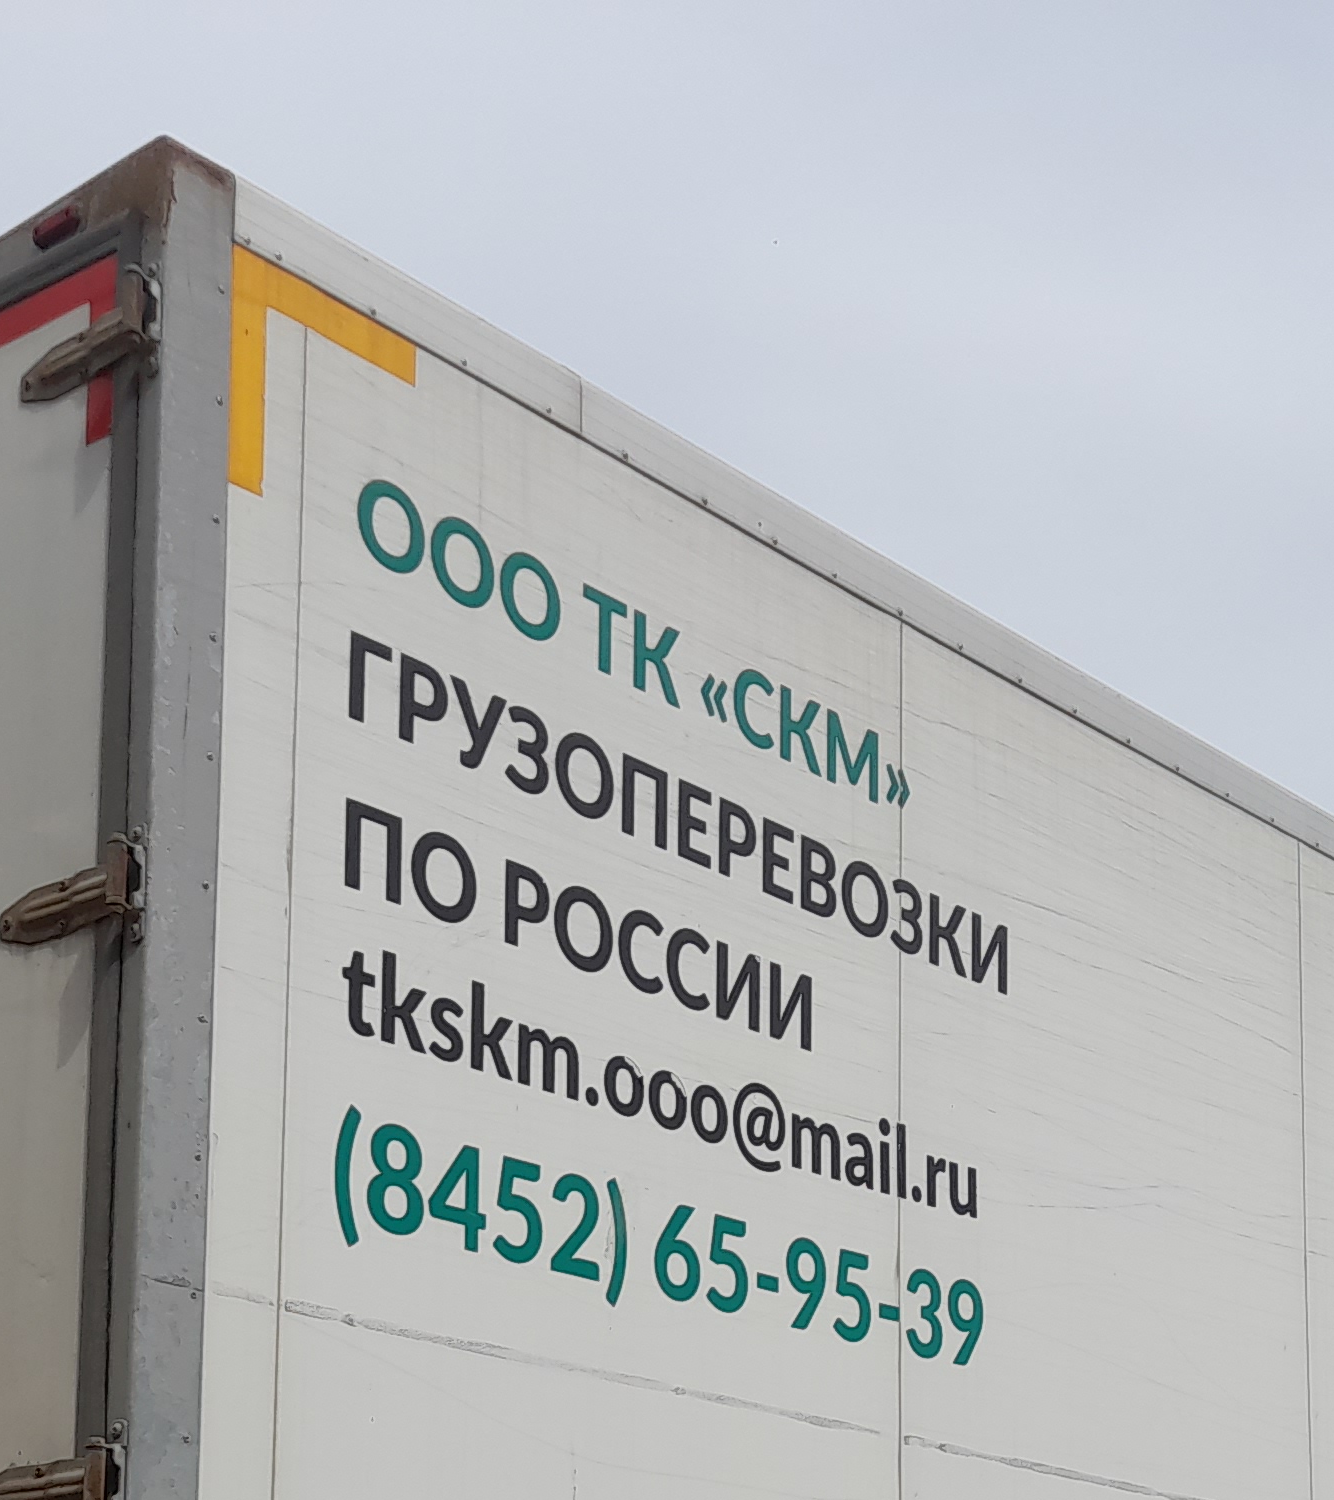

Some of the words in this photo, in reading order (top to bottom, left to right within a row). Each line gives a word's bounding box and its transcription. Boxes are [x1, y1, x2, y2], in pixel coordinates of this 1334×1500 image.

[357, 480, 560, 641] ООО
[583, 584, 680, 708] ТК
[701, 669, 910, 809] «СКМ»
[345, 798, 476, 923] ПО
[505, 859, 812, 1051] РОССИИ
[349, 631, 1007, 995] ГРУЗОПЕРЕВОЗКИ
[342, 950, 978, 1218] tkskm.ooo@mail.ru
[335, 1105, 627, 1307] (8452)
[654, 1205, 983, 1366] 65-95-39
